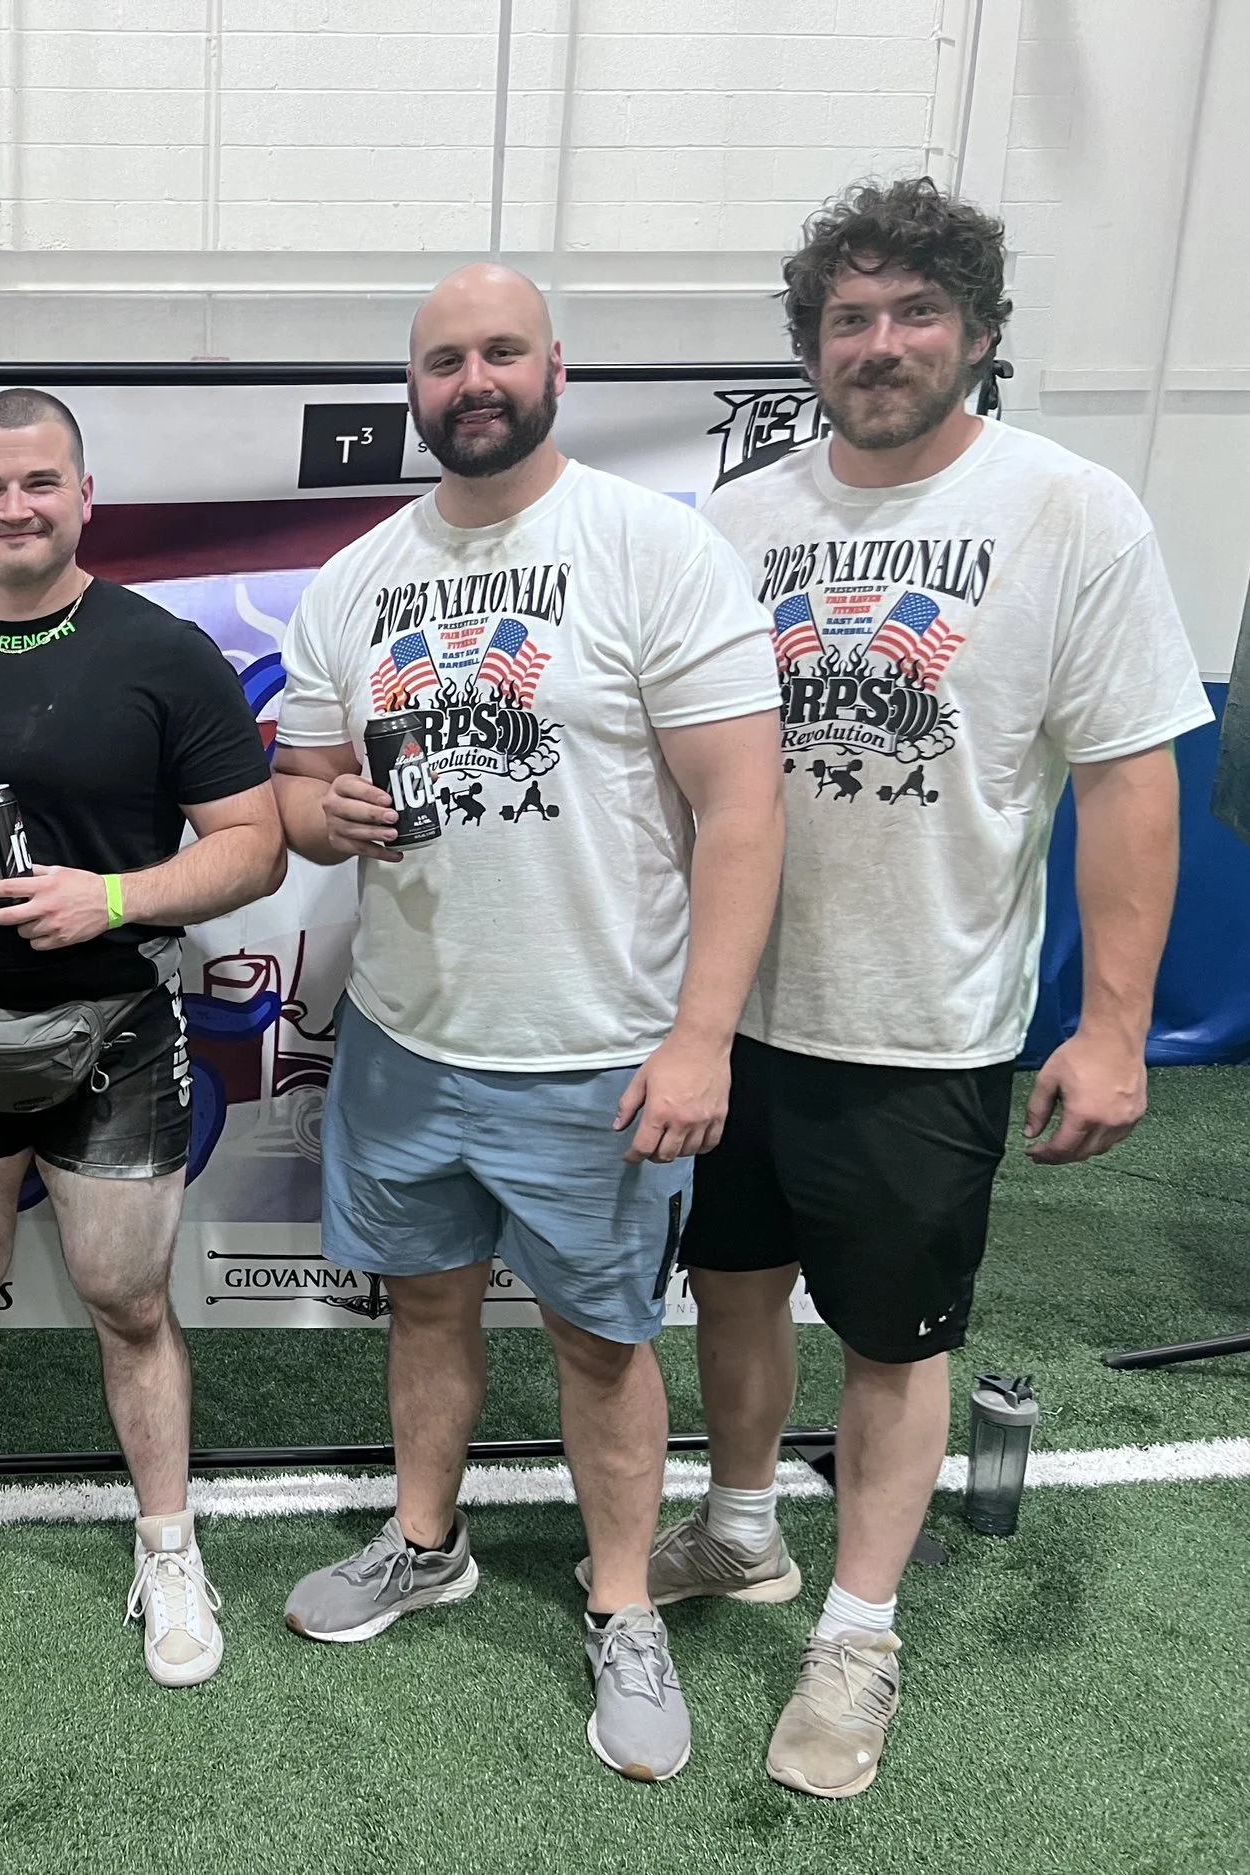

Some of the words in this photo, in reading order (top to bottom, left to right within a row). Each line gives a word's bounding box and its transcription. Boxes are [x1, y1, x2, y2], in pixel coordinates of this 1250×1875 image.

[758, 541, 819, 604] 2025
[816, 539, 996, 607] NATIONALS
[824, 586, 874, 594] PRESENTED
[370, 581, 430, 648] 2025
[429, 563, 572, 626] NATIONALS
[826, 617, 853, 625] EAST
[786, 677, 895, 727] RPS
[414, 702, 498, 753] RPS
[781, 722, 886, 749] Revolution
[431, 749, 499, 772] volution
[389, 761, 437, 812] ICE
[224, 1268, 358, 1288] GIOVANNA
